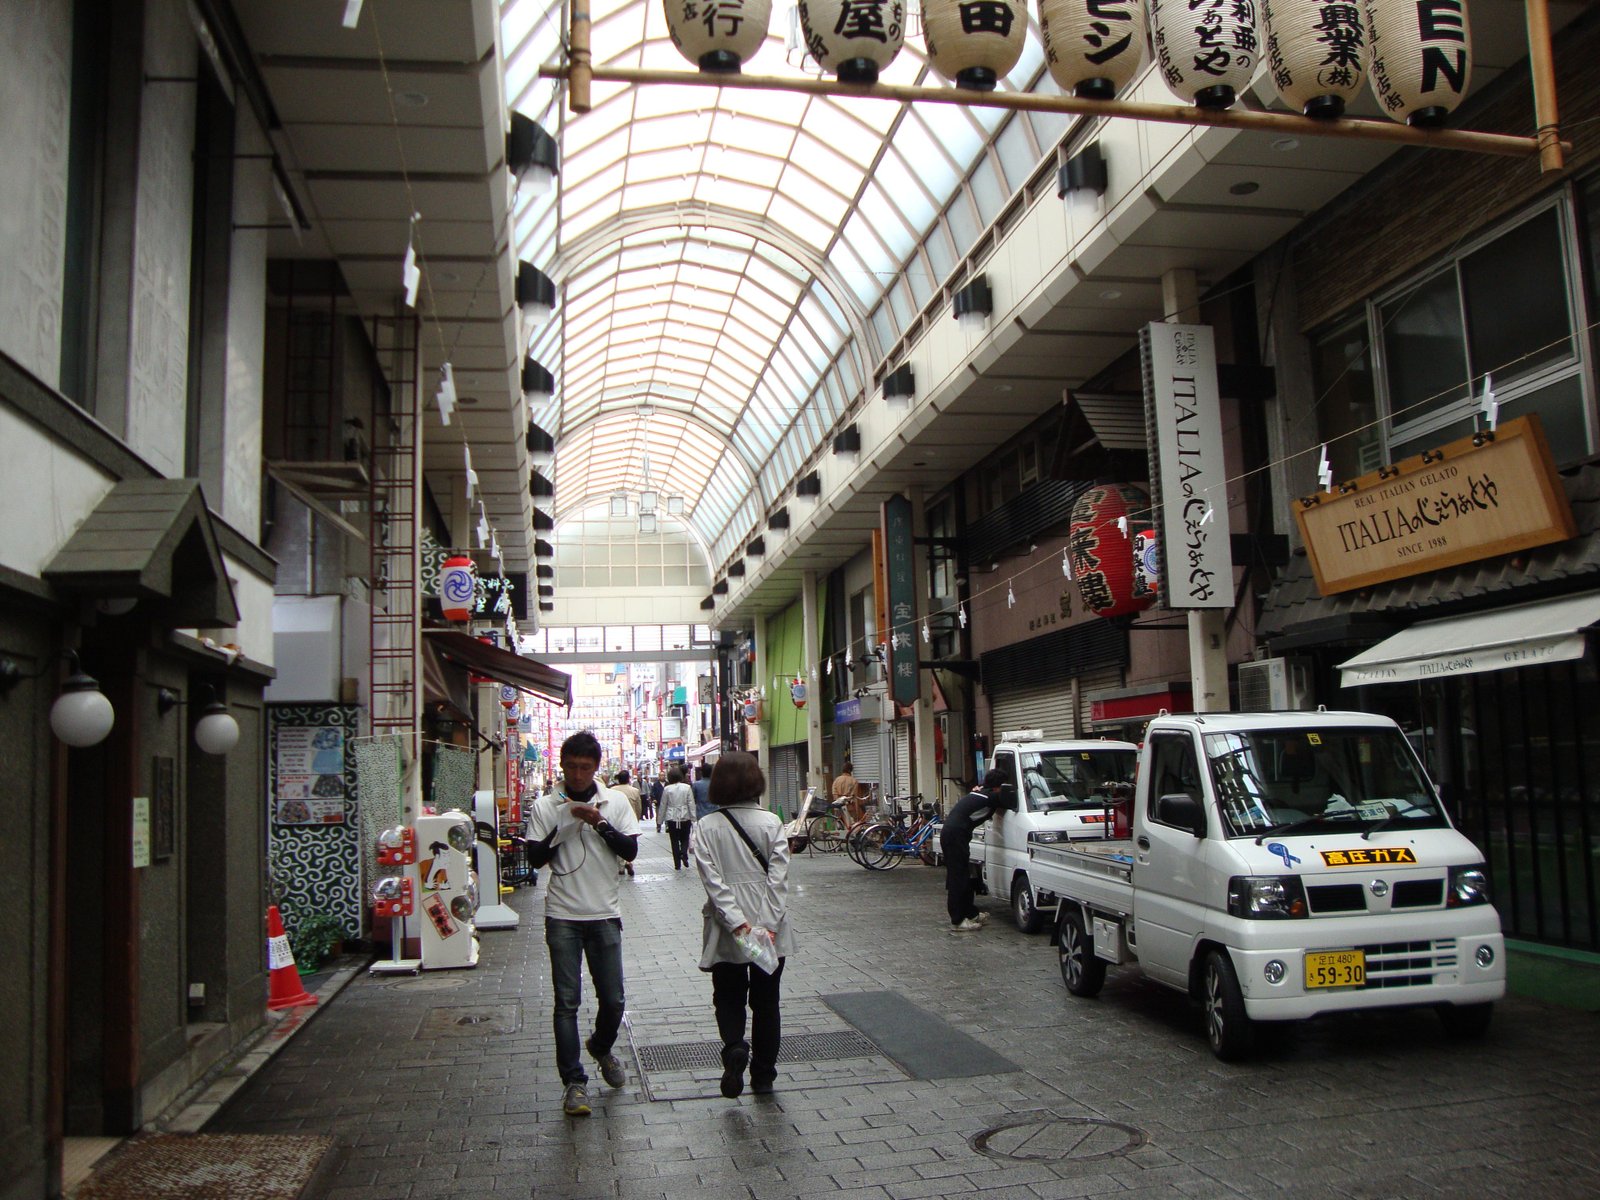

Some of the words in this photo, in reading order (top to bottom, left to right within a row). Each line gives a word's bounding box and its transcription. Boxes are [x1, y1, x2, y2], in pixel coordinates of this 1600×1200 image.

[702, 3, 744, 37] 行
[834, 0, 888, 43] 屋
[958, 1, 1014, 37] 田
[1313, 0, 1365, 89] 興業(株)
[1354, 494, 1376, 508] REAL
[1380, 481, 1415, 500] ITALIAN
[1420, 466, 1458, 486] GELATO
[1397, 542, 1424, 557] SINCE
[1427, 535, 1447, 549] 1988
[1325, 848, 1412, 865] 高圧ガス
[1317, 965, 1362, 985] 59-30
[1337, 954, 1352, 964] 480
